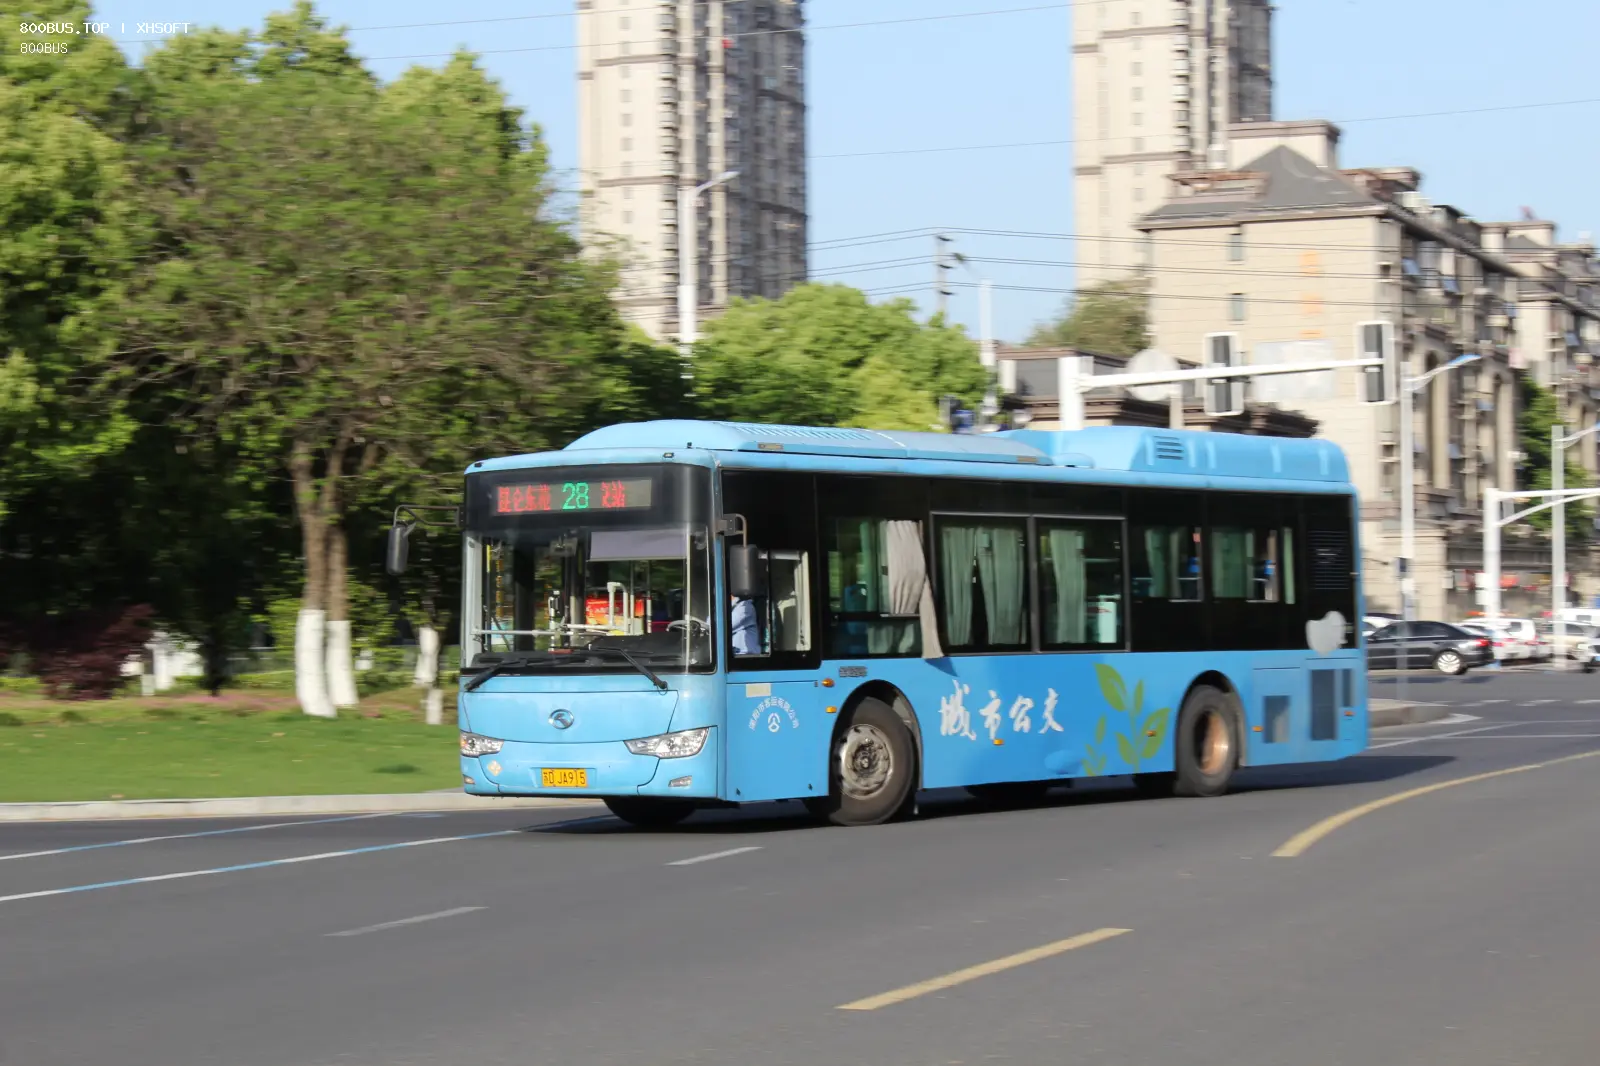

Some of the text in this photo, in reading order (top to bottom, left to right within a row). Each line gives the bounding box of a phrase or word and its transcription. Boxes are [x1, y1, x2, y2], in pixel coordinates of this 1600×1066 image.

[562, 482, 590, 510] 28
[938, 679, 1064, 741] 城市公交
